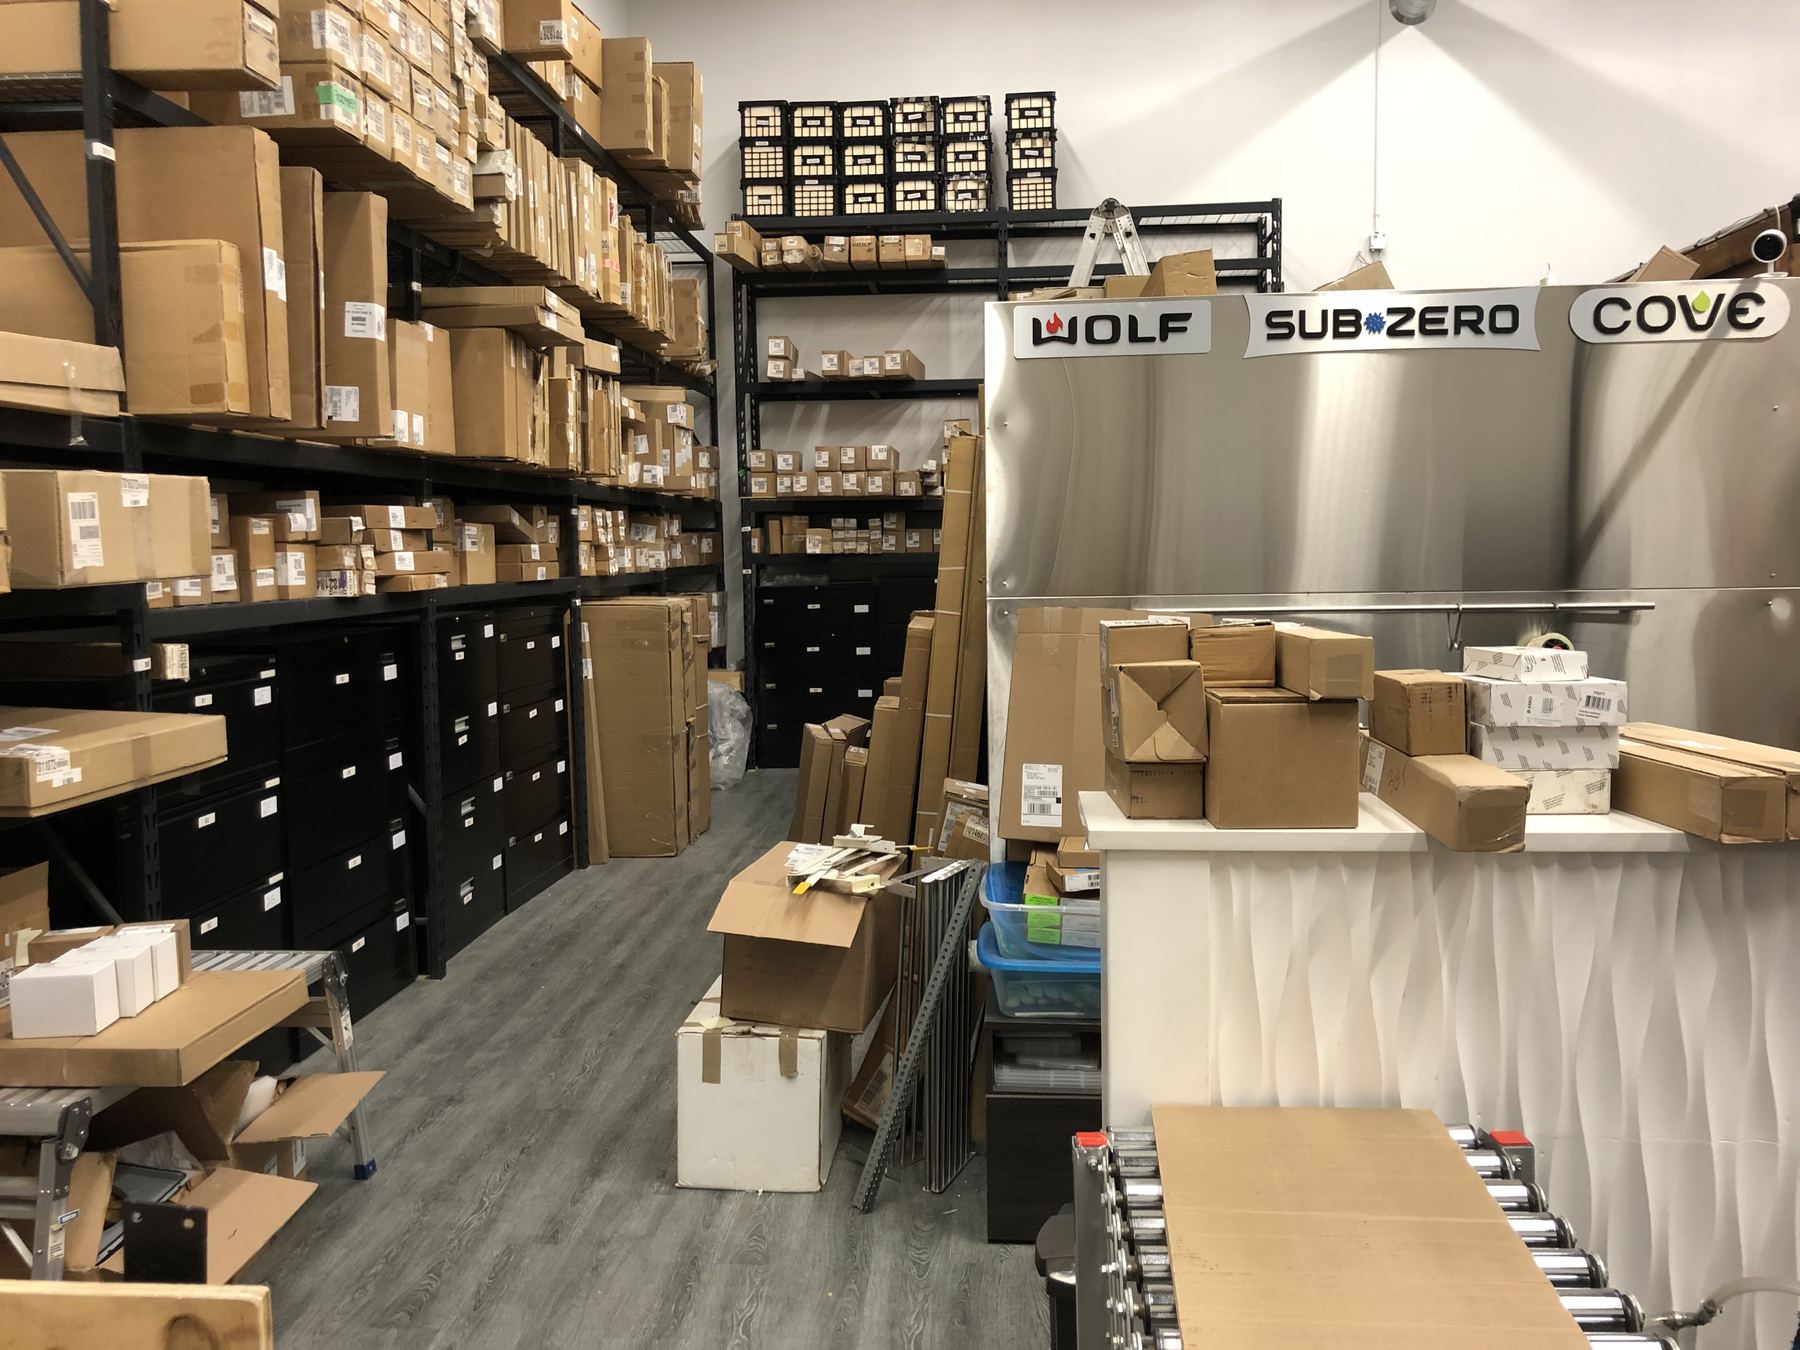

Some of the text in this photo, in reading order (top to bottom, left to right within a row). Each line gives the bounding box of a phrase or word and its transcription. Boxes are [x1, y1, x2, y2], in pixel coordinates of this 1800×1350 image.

[1032, 312, 1192, 346] WOLF
[1265, 304, 1519, 340] SUB ZERO
[1593, 292, 1766, 335] COVE
